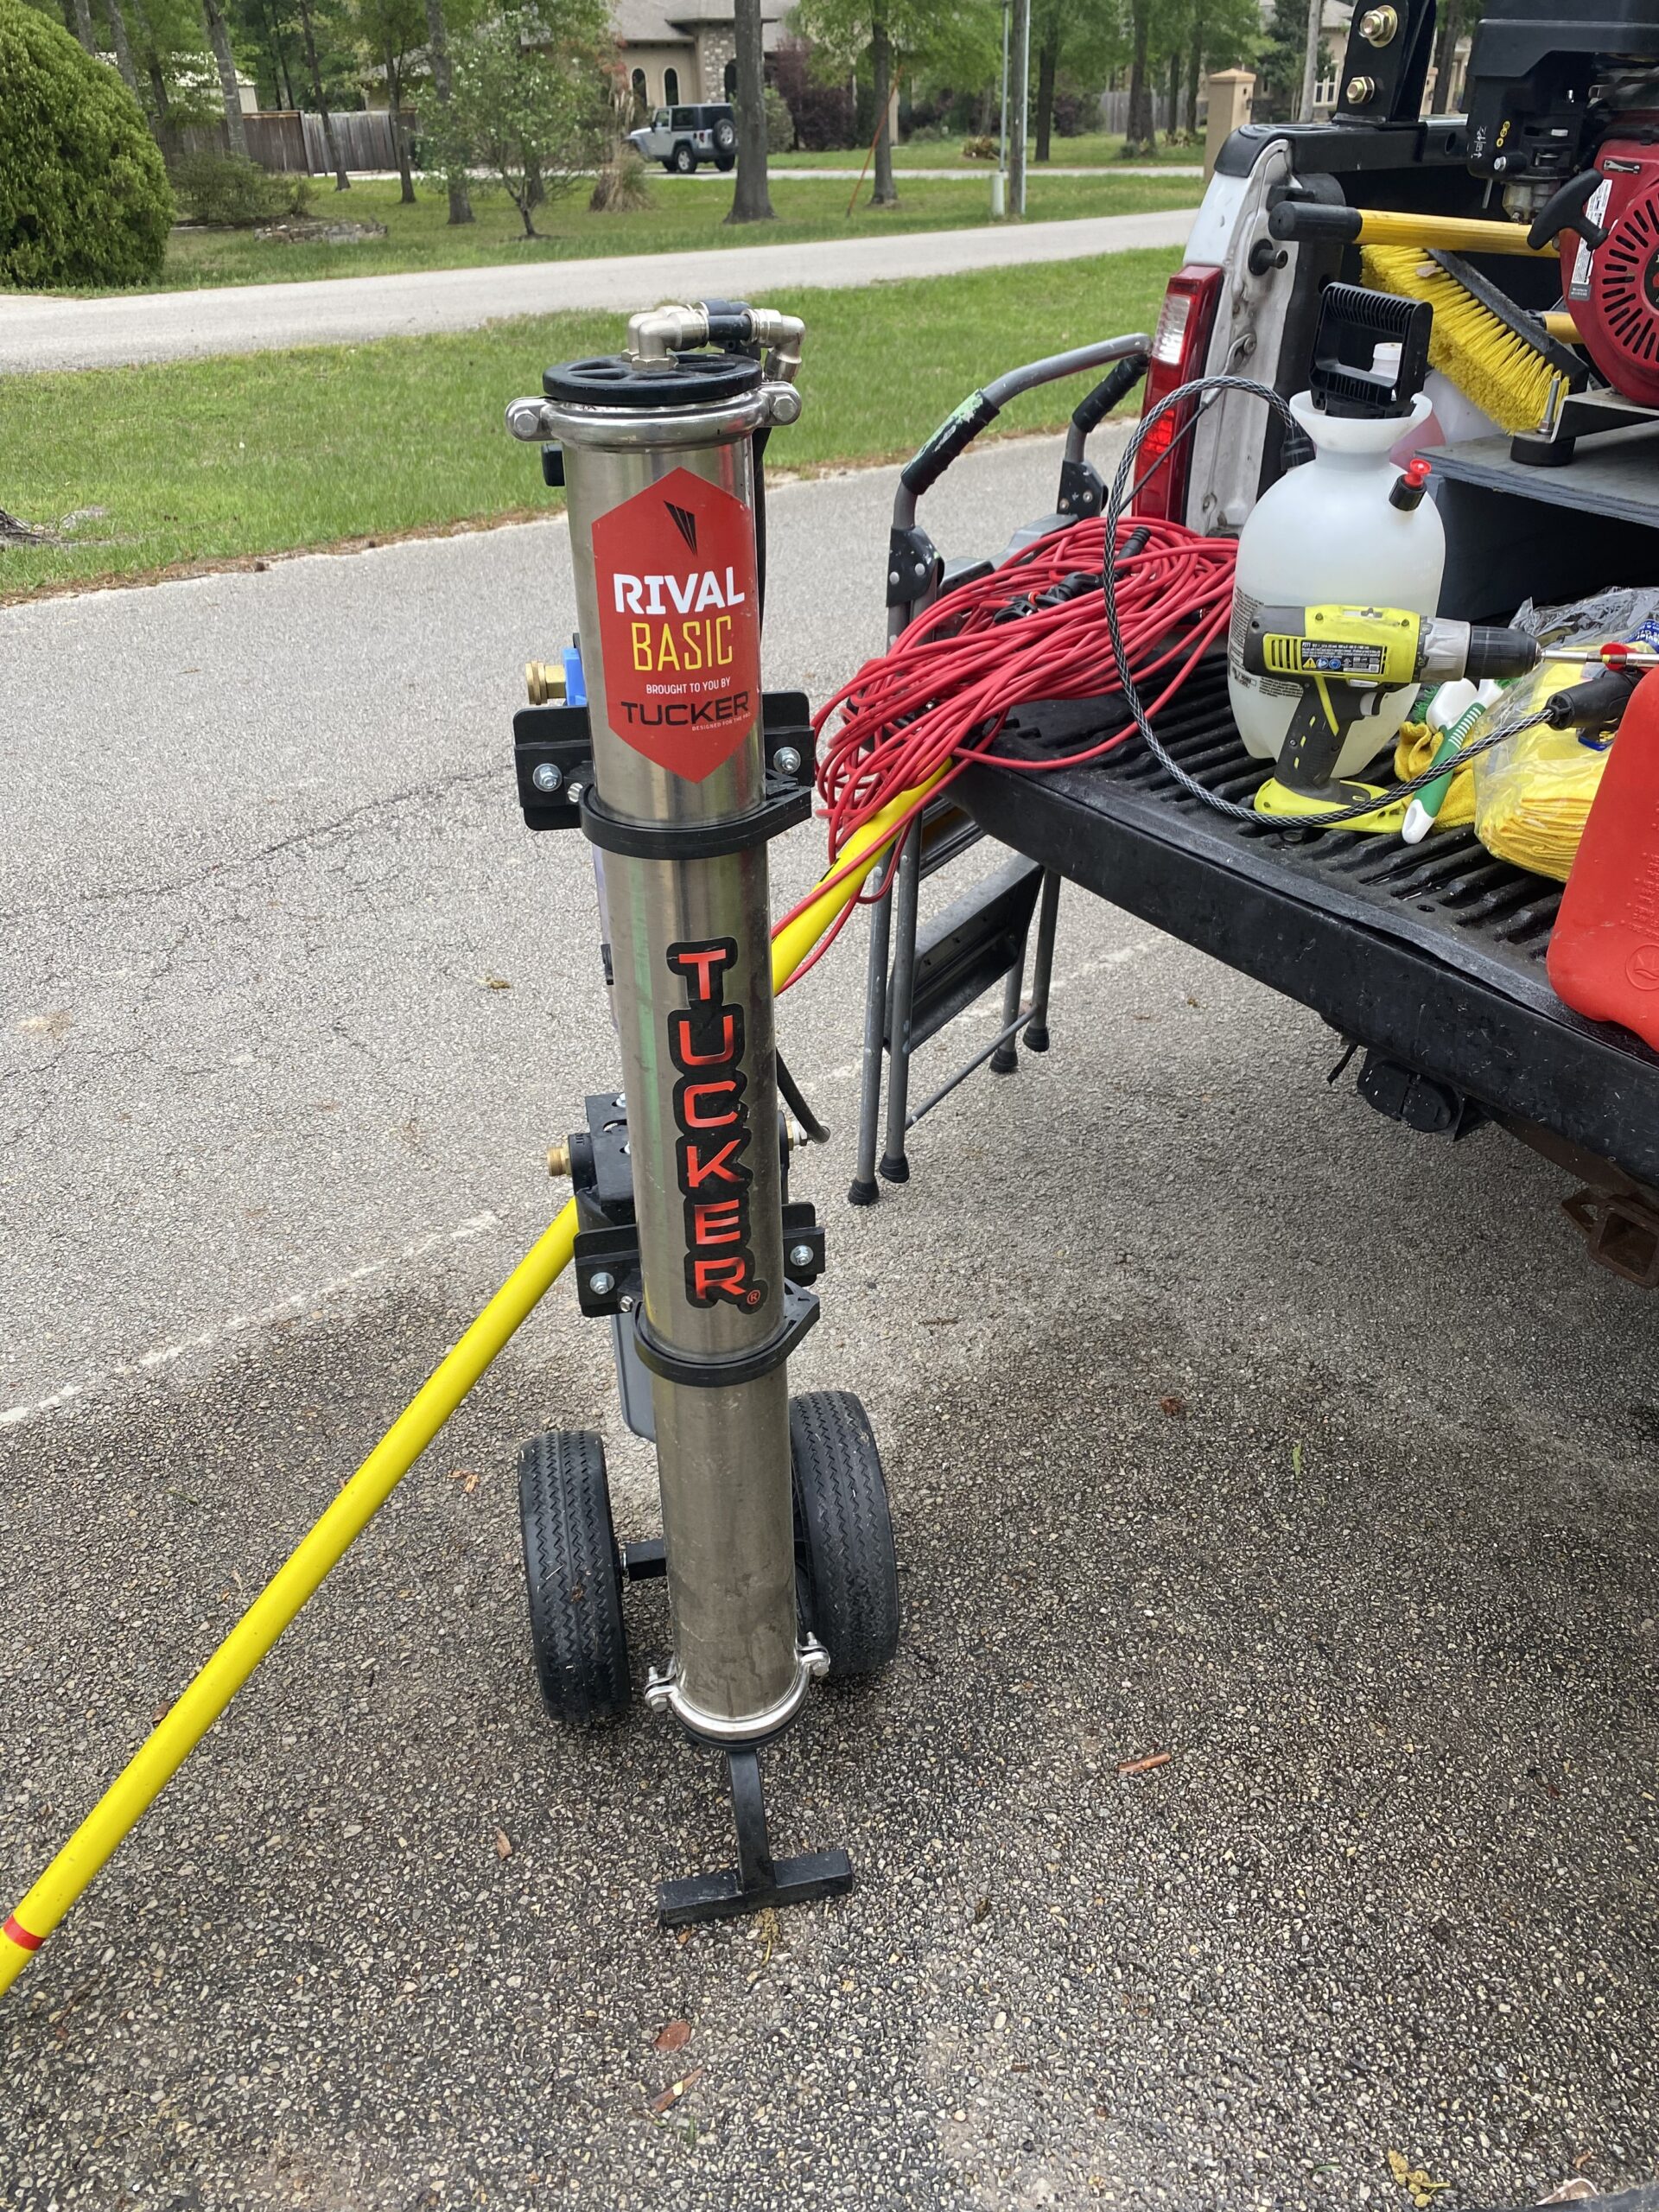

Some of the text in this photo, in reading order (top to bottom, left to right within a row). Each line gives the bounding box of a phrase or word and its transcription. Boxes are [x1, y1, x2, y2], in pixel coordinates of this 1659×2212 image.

[613, 566, 746, 615] RIVAL
[631, 615, 734, 671] BASIC
[645, 677, 731, 695] BROUGHT TO YOU BY
[620, 690, 748, 727] TUCKER
[691, 721, 721, 732] DESIGNED
[678, 949, 747, 1300] TUCKER
